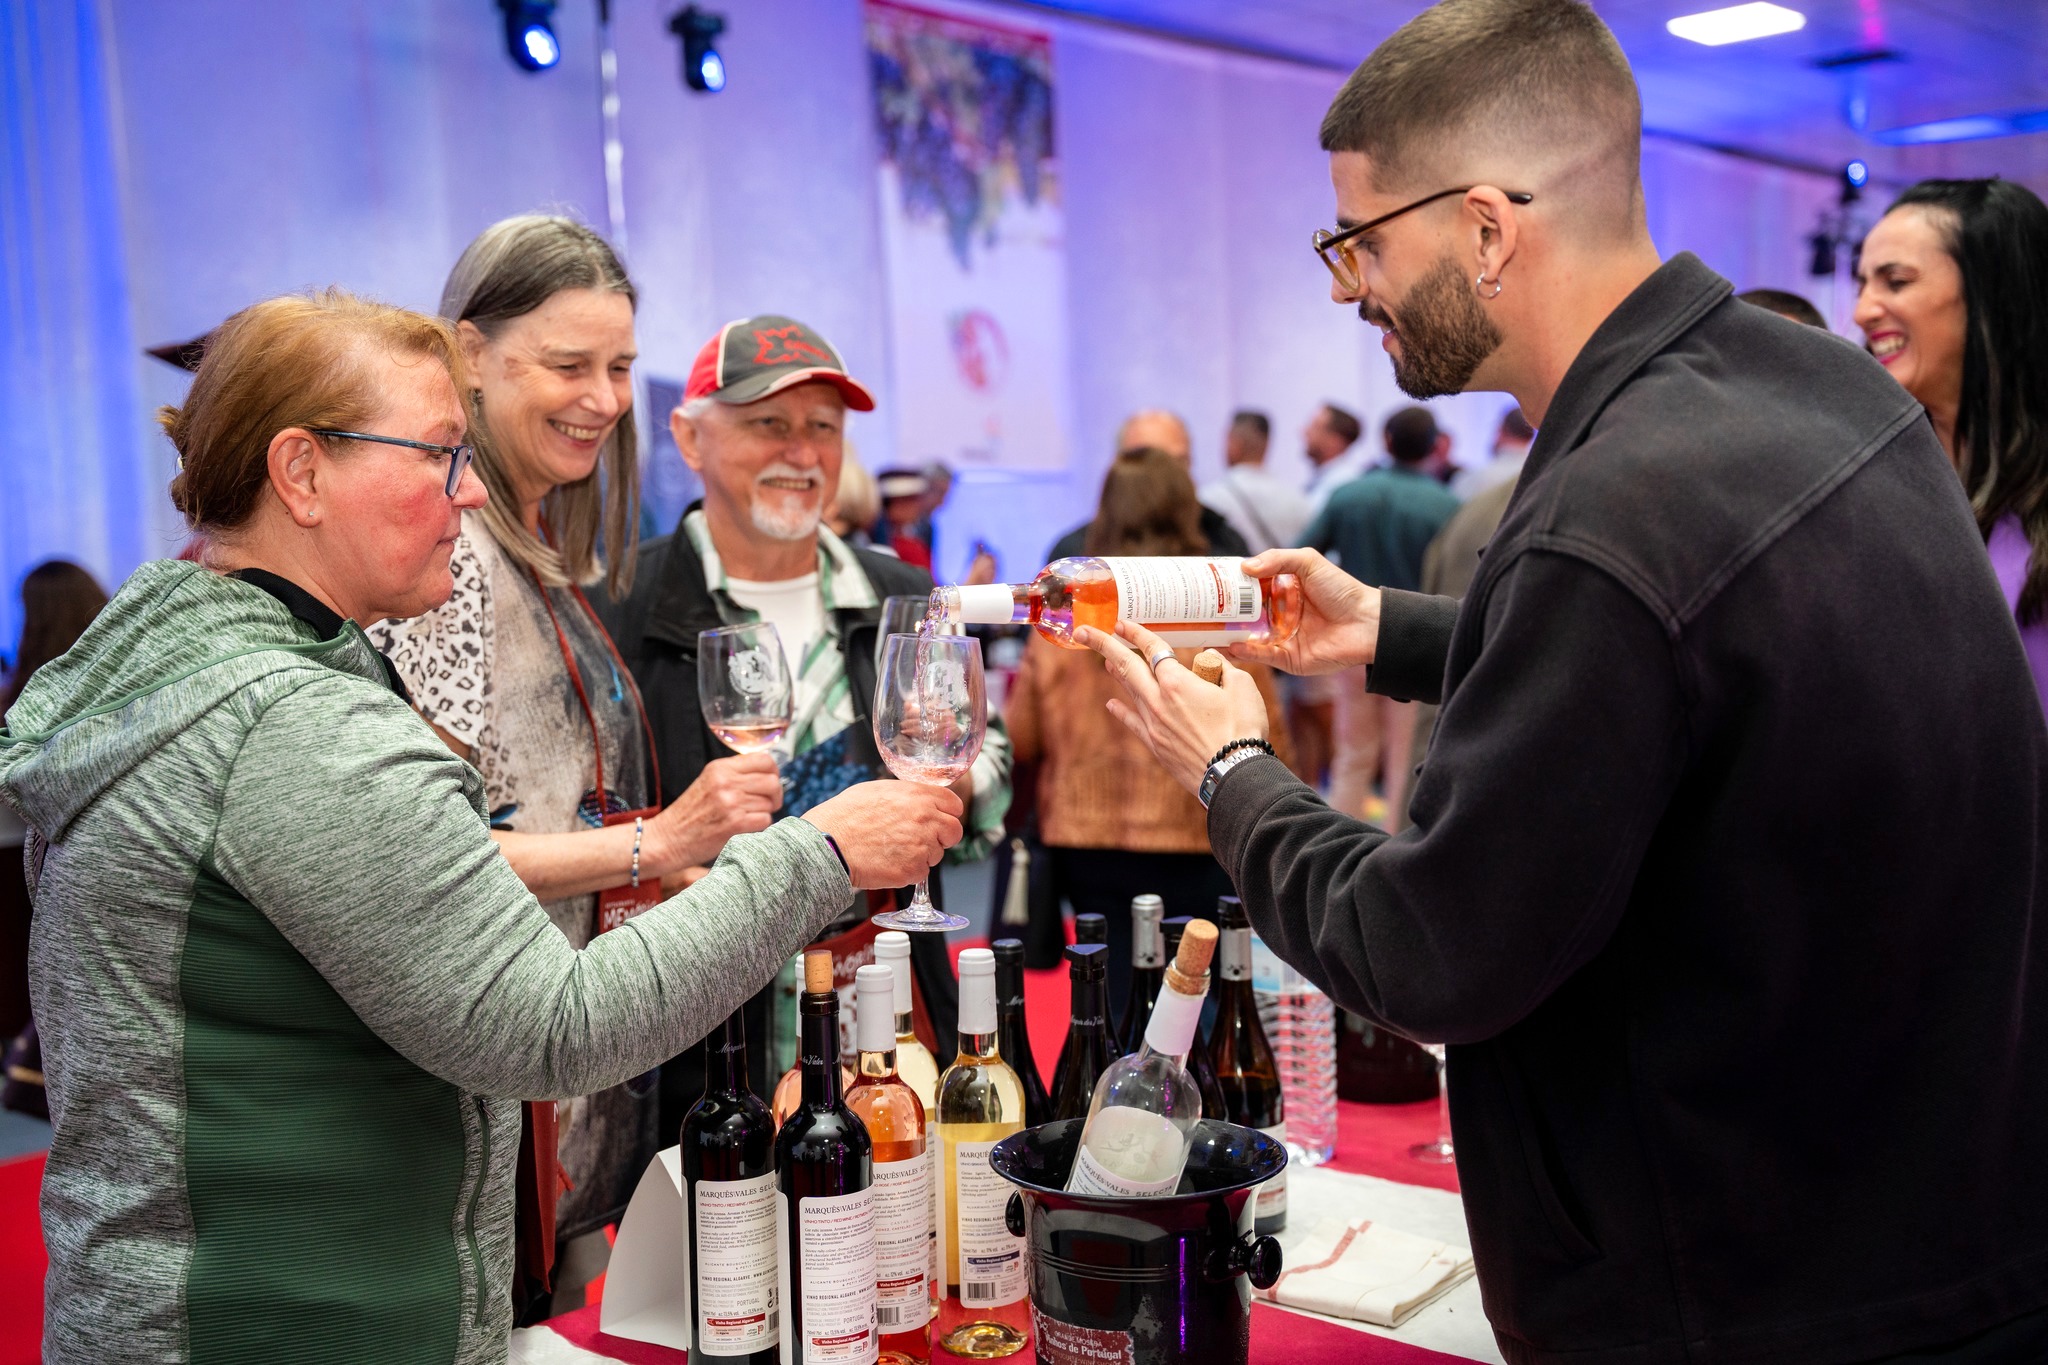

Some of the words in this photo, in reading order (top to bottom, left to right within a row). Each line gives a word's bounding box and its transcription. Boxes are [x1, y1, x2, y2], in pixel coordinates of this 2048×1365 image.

[1135, 1186, 1172, 1197] SELECTA
[737, 1298, 759, 1306] PORTUGAL
[843, 1315, 864, 1323] PORTUGAL
[1069, 1343, 1078, 1353] de
[1081, 1346, 1121, 1360] Portugal
